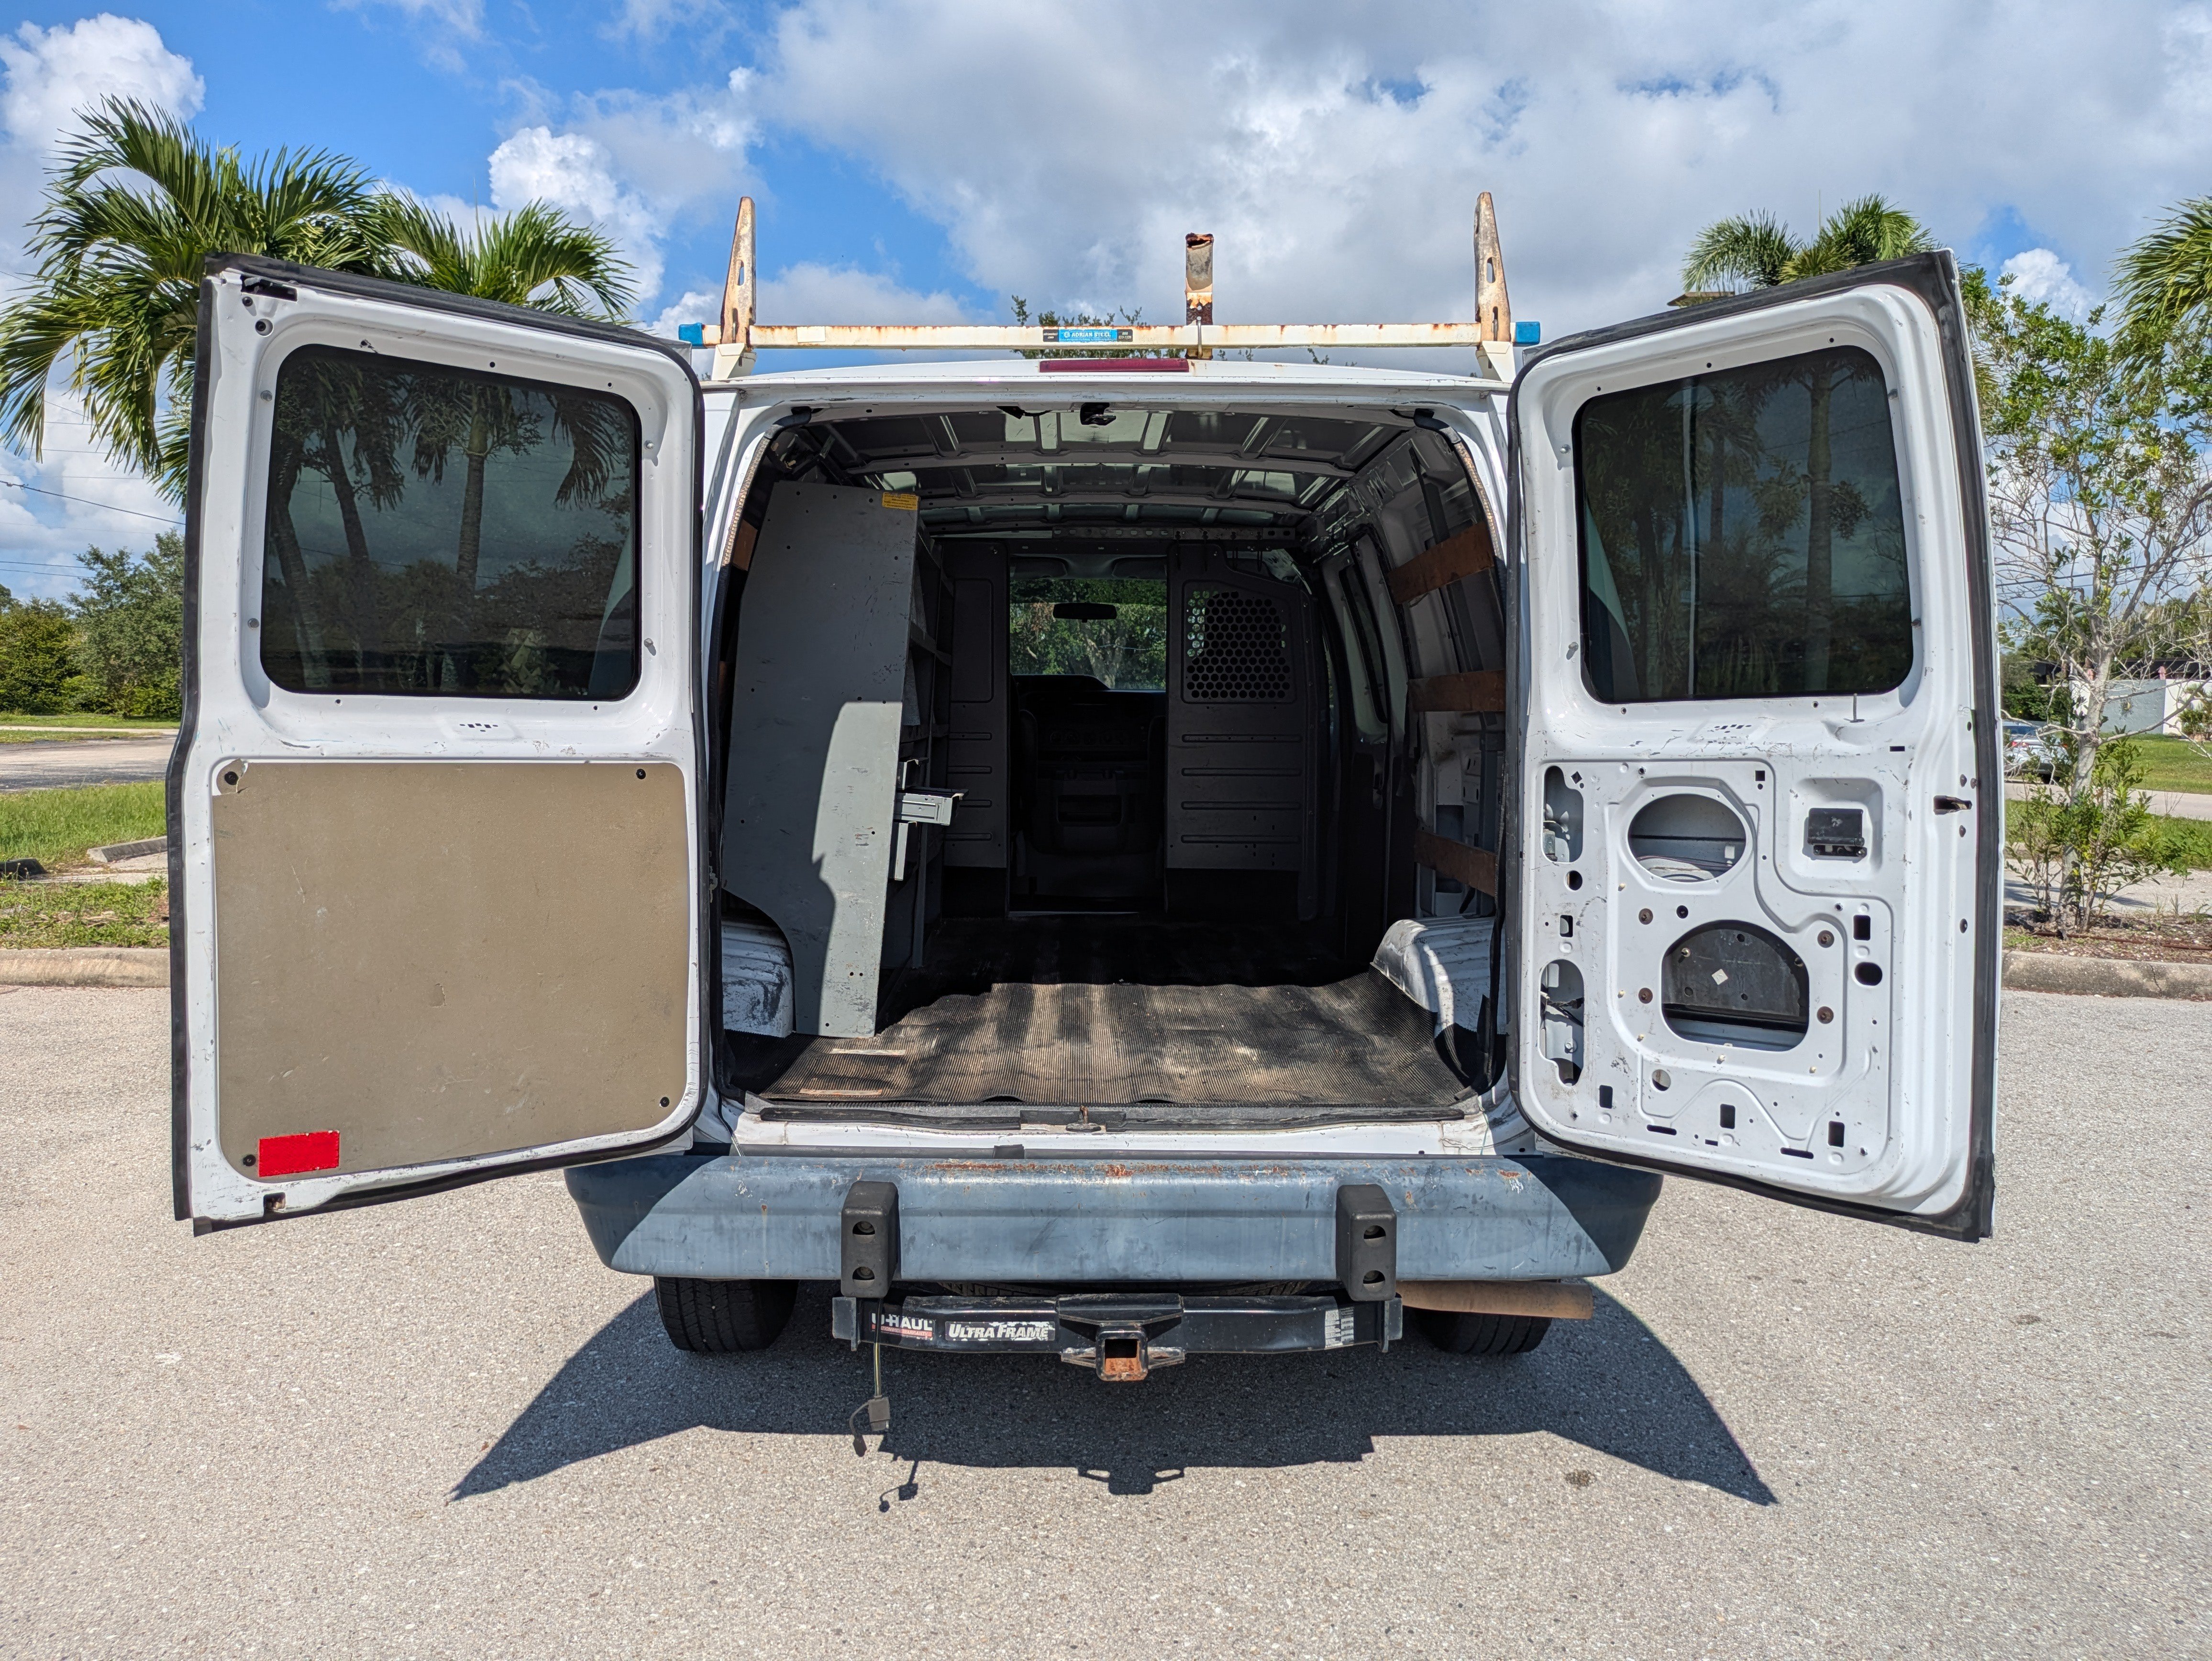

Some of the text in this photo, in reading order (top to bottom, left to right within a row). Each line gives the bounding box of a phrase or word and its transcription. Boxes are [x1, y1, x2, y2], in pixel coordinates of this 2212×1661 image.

[872, 1313, 933, 1331] U-HAUL
[949, 1324, 1049, 1338] ULTRA FRAME
